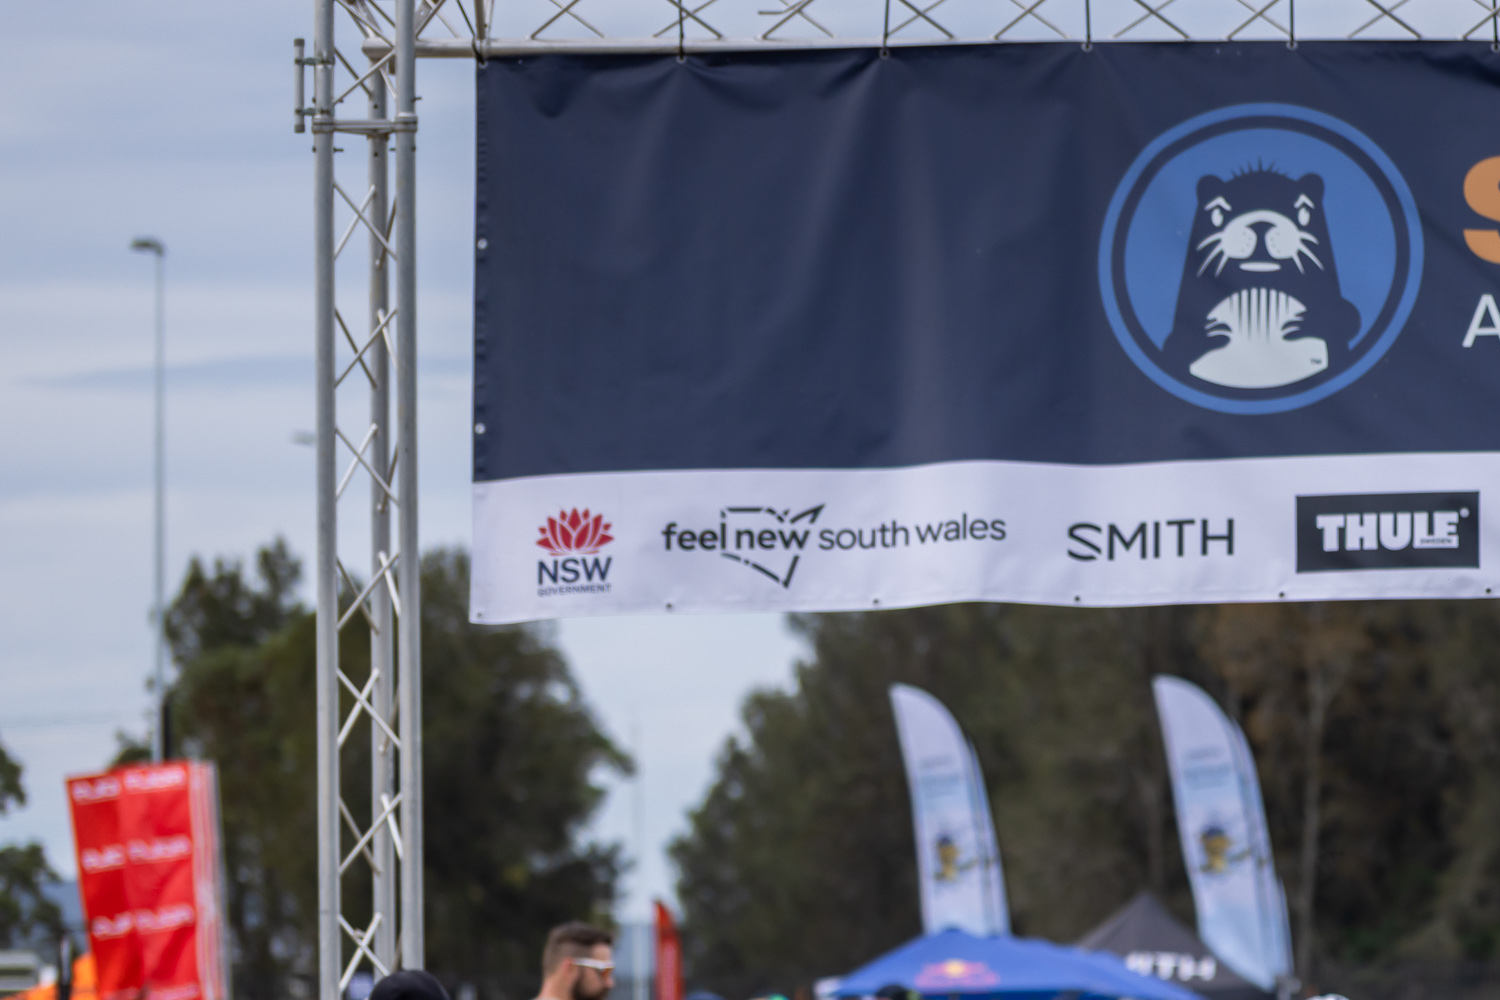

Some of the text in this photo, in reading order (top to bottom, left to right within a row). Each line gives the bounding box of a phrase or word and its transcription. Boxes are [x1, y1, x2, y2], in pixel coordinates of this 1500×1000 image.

[662, 514, 1008, 551] feel new south wales
[1067, 517, 1236, 562] SMITH
[1315, 510, 1460, 552] THULE
[537, 556, 613, 585] NSW
[537, 583, 613, 597] GOVERNMENT
